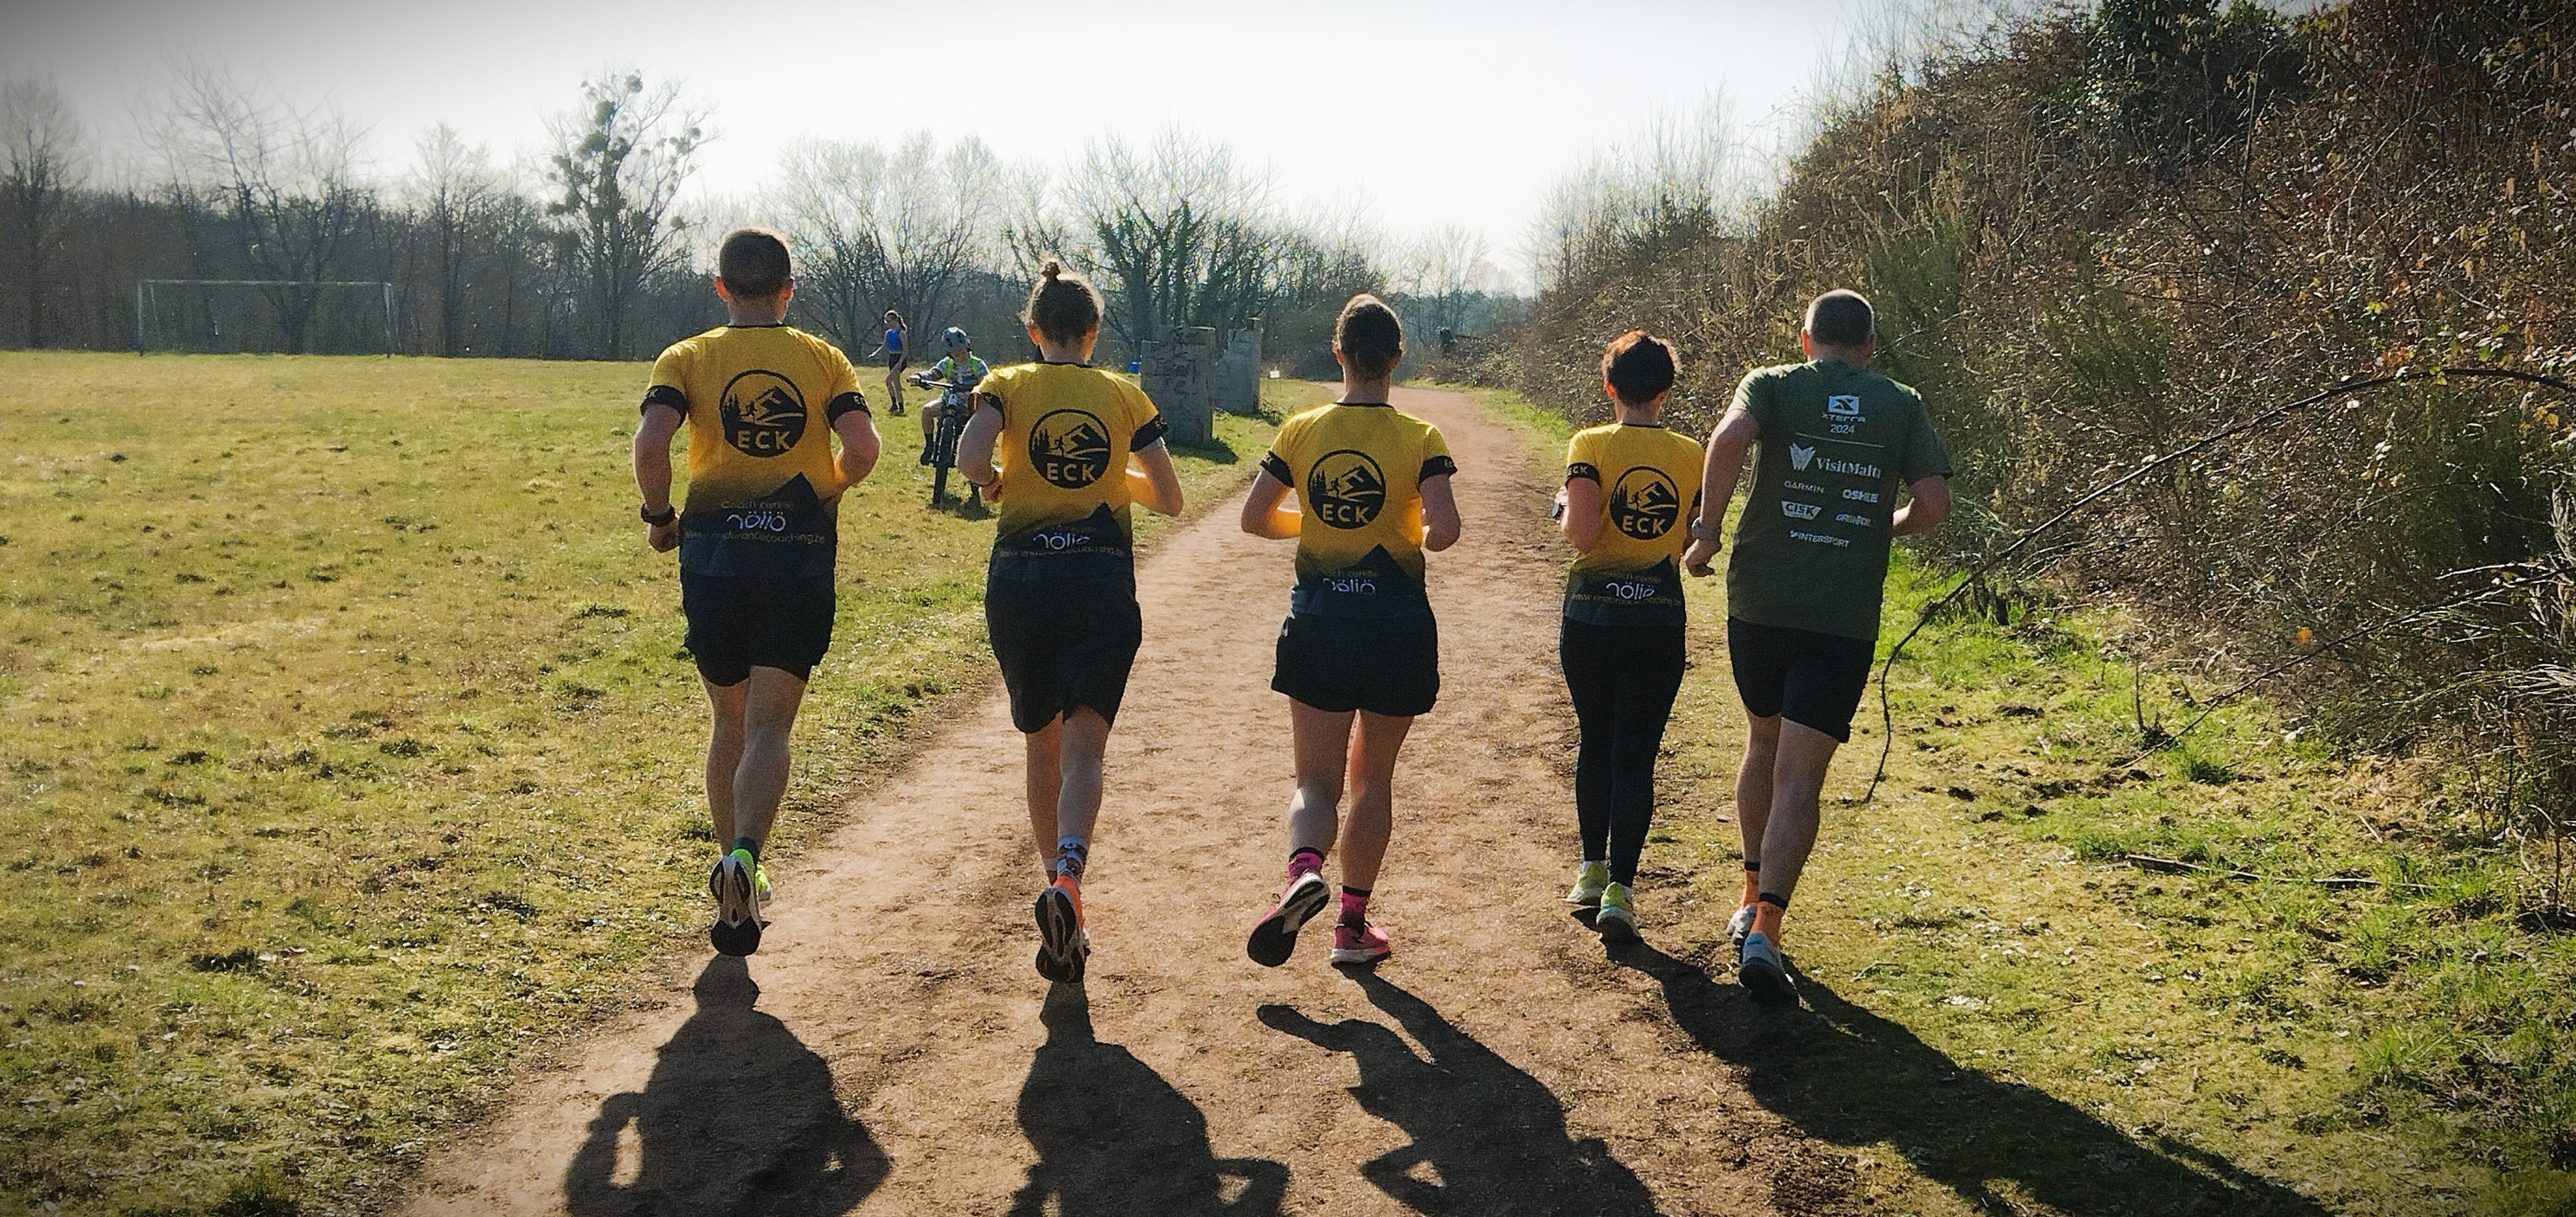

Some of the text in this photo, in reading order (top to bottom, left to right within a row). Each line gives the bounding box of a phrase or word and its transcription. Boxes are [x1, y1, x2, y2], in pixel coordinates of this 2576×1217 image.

[1830, 424, 1855, 434] 2024
[737, 430, 791, 450] ECK
[1047, 463, 1095, 481] ECK
[1784, 480, 1825, 494] GARMIN
[1323, 503, 1369, 523] ECK
[1785, 503, 1815, 516] CISK
[1622, 515, 1667, 535] ECK
[1798, 533, 1850, 548] INTERSPORT
